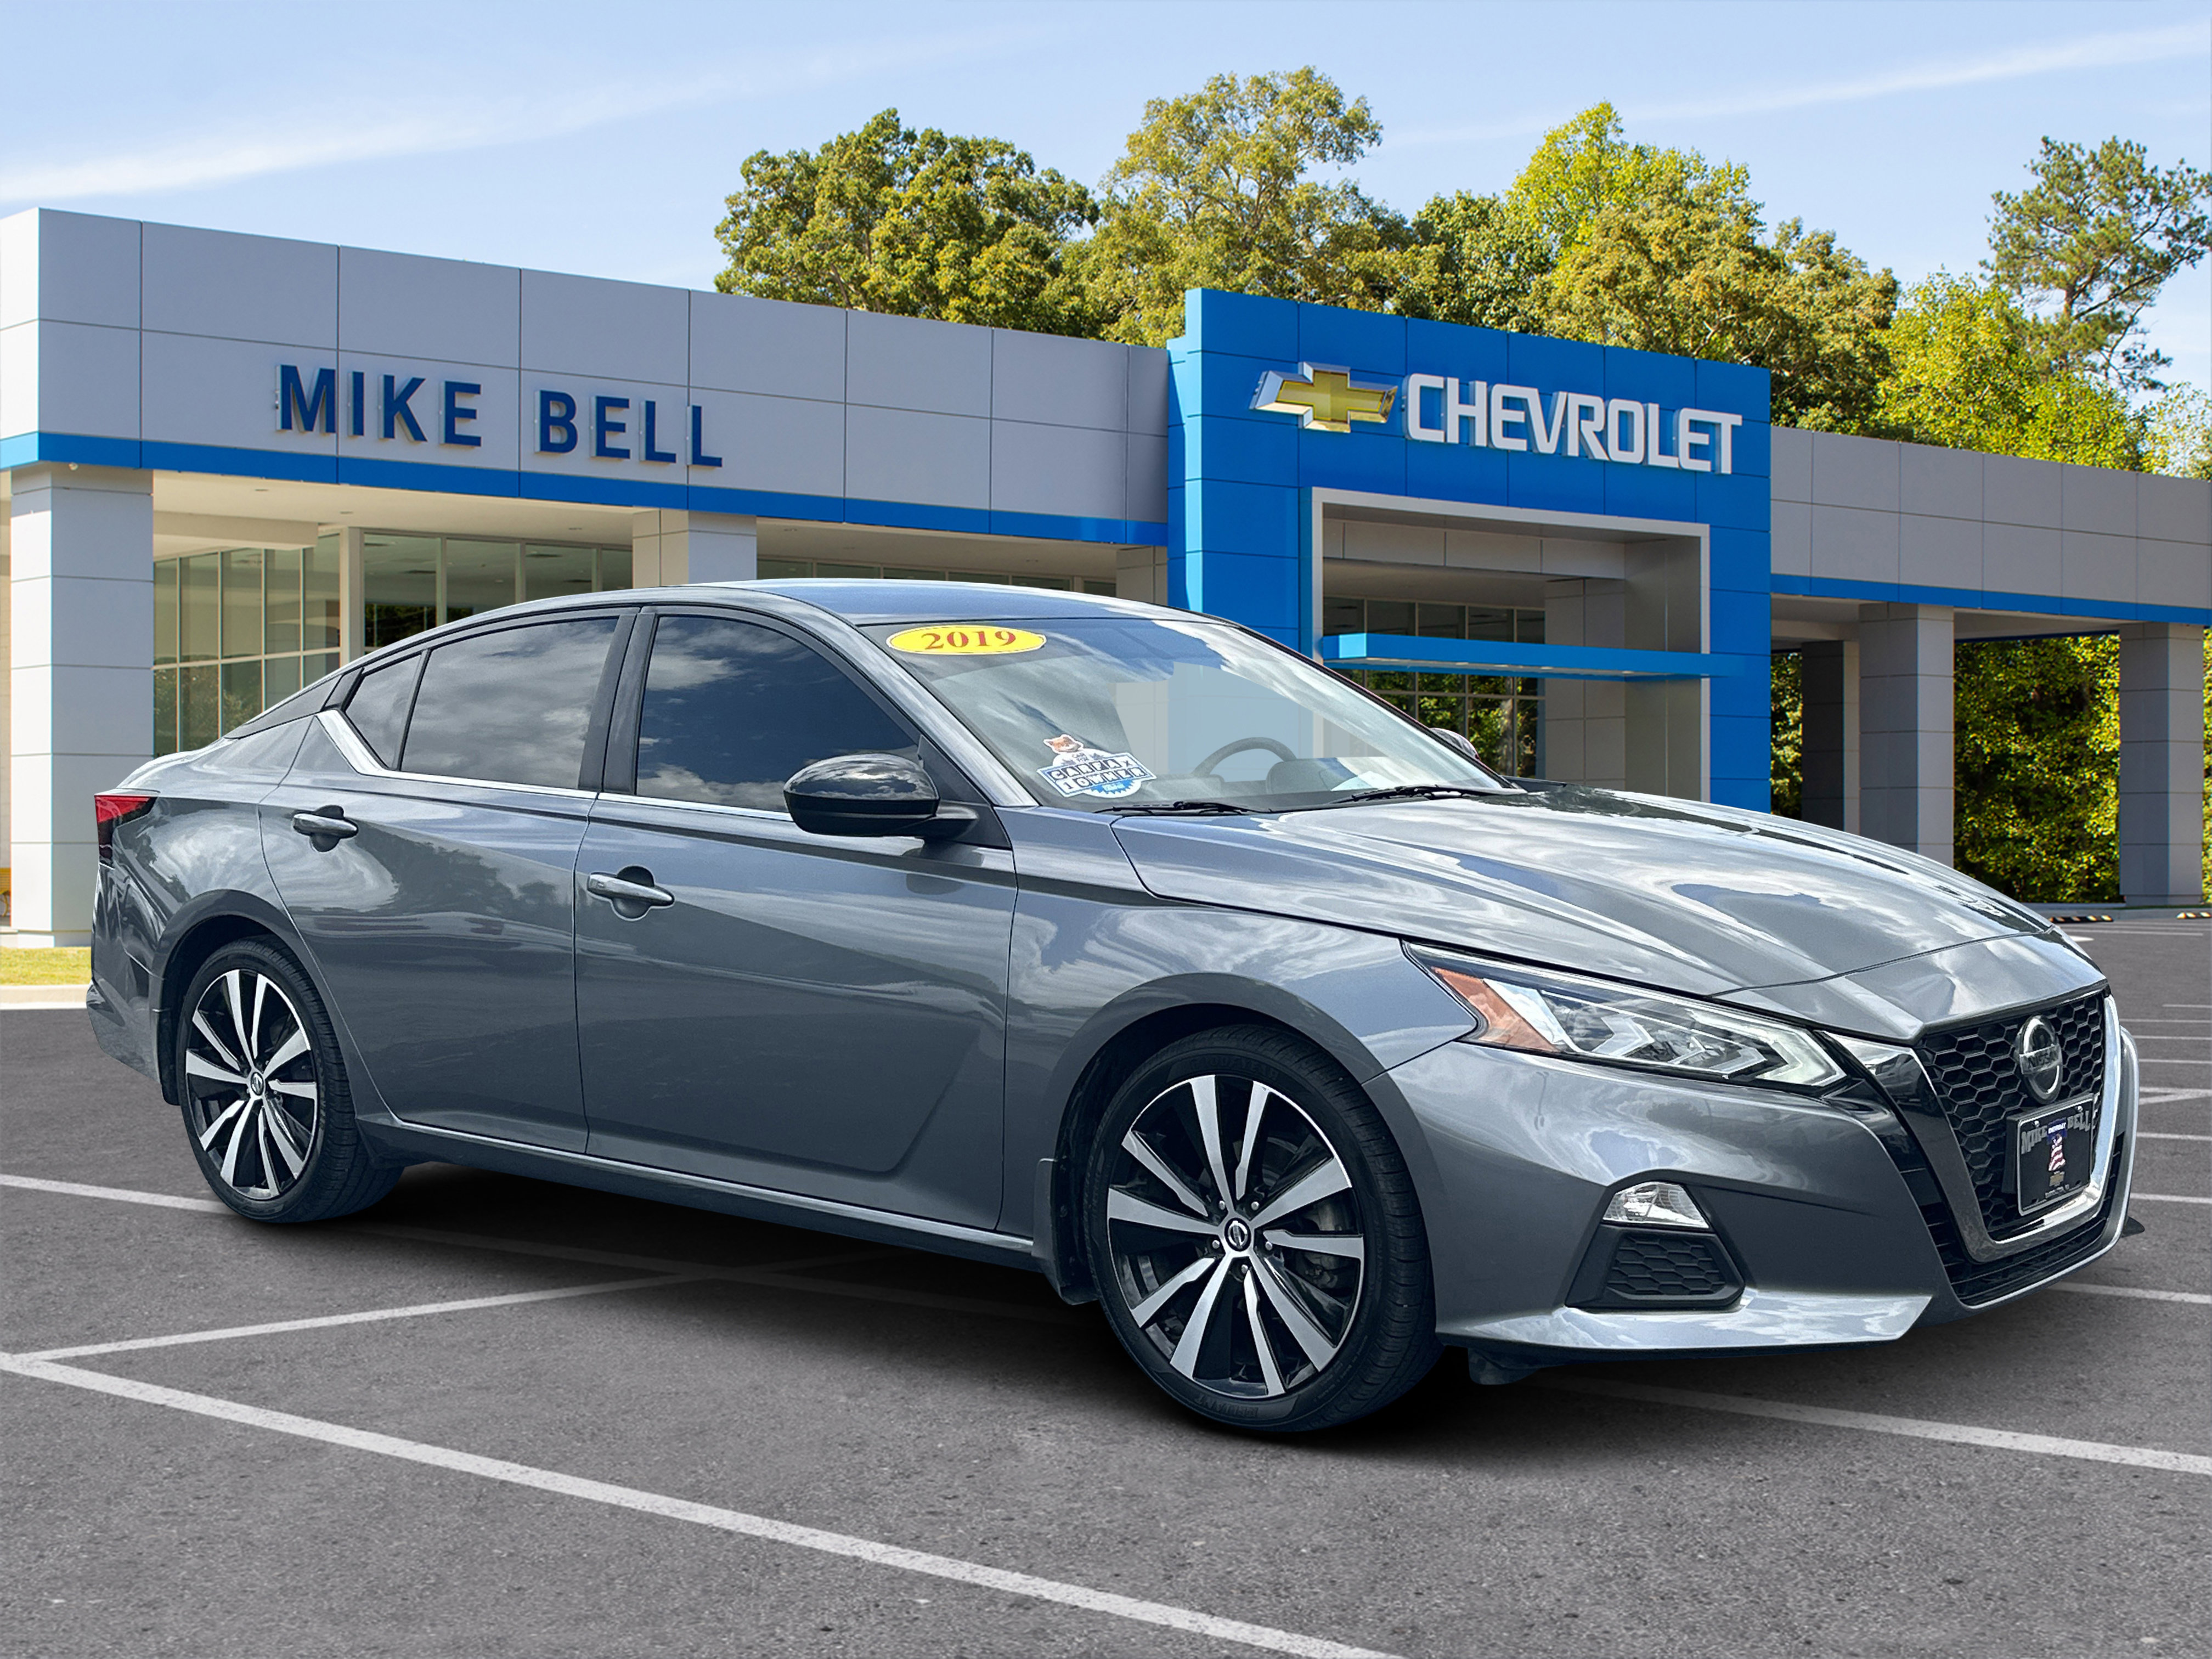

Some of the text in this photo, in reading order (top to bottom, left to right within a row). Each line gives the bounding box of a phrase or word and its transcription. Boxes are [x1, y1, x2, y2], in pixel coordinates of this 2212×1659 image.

[277, 364, 723, 467] MIKE BELL
[1404, 373, 1743, 475] CHEVROLET
[921, 630, 1016, 650] 2019
[1049, 759, 1132, 780] CARFAX
[1063, 781, 1074, 790] 1
[1074, 768, 1146, 787] OWNER
[2021, 1125, 2047, 1155] MIKE
[2067, 1110, 2091, 1132] BELL
